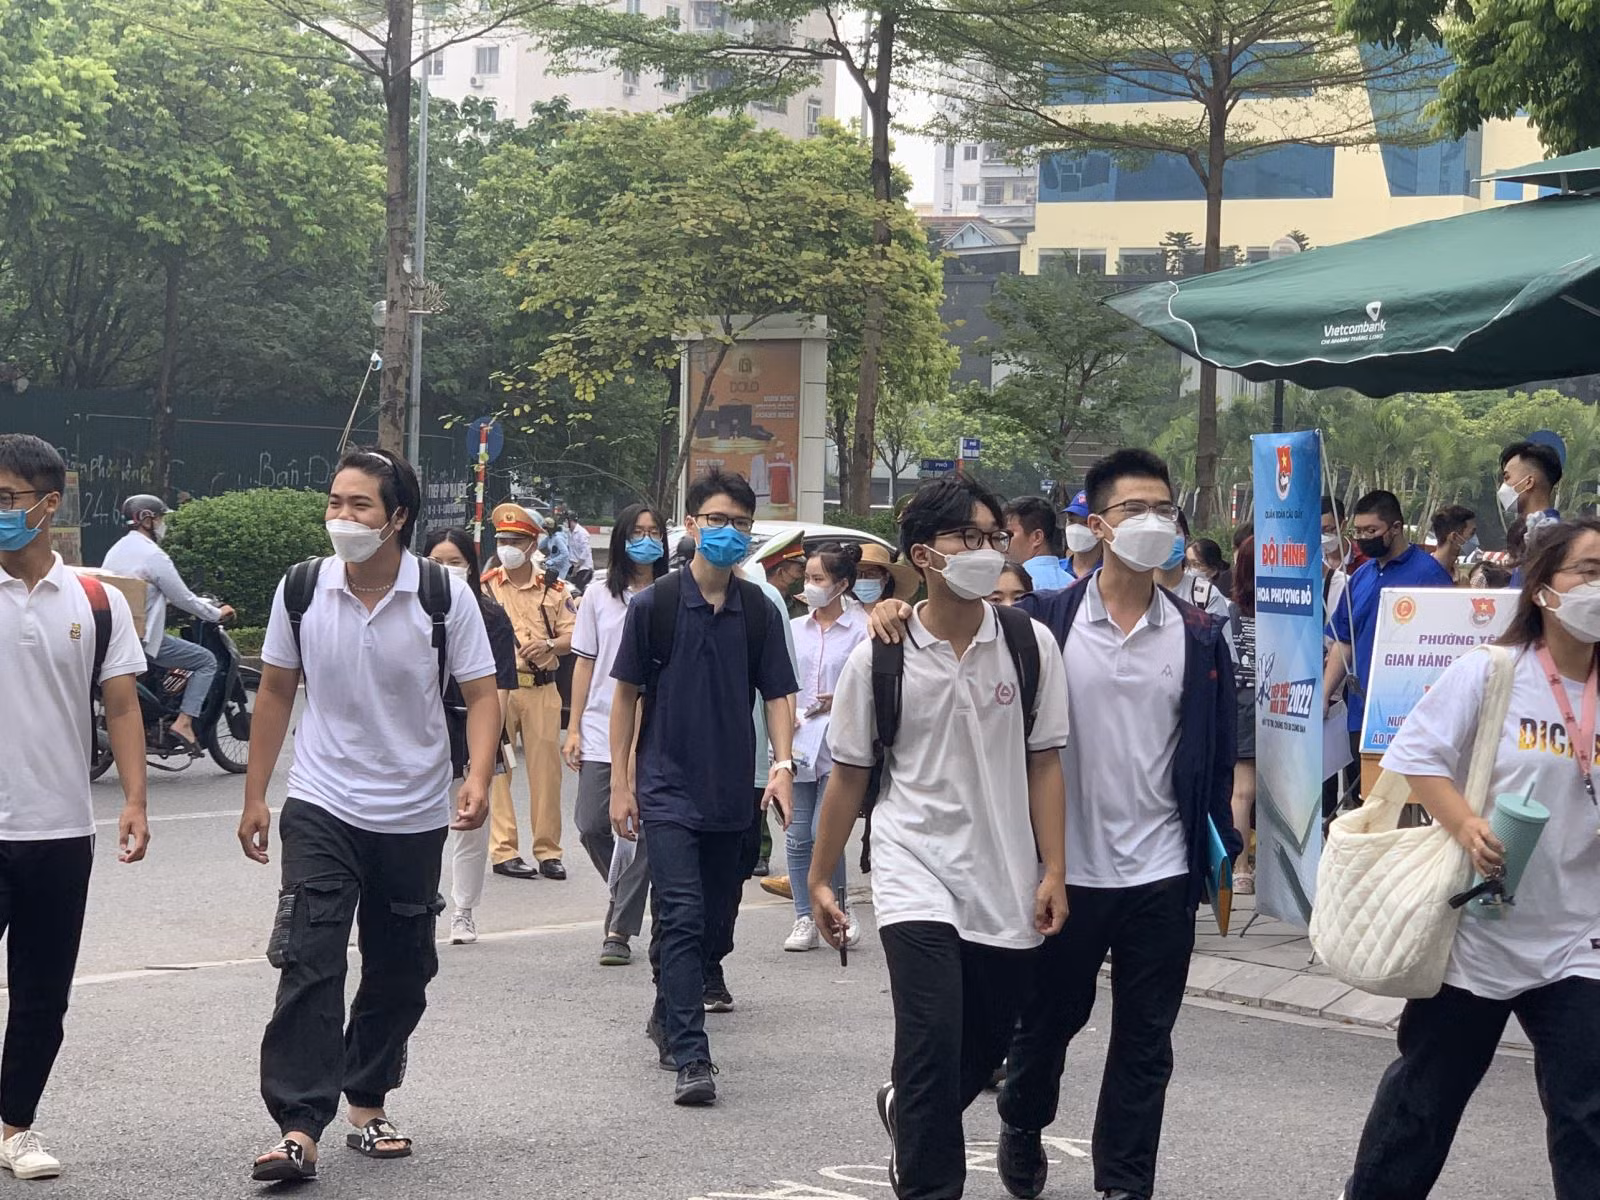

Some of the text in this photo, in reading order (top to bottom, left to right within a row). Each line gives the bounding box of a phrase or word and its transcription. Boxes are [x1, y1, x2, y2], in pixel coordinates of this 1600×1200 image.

[1324, 319, 1387, 337] Vietcombank
[1262, 536, 1308, 573] ĐỘI HÌNH
[1257, 585, 1312, 607] HOA PHƯỢNG ĐỎ
[1418, 633, 1499, 646] PHƯỜNG YÊ
[1384, 652, 1453, 668] GIAN HÀNG
[1288, 683, 1313, 715] 2022
[1387, 714, 1408, 727] NƯỚ
[1372, 731, 1385, 744] ÁO
